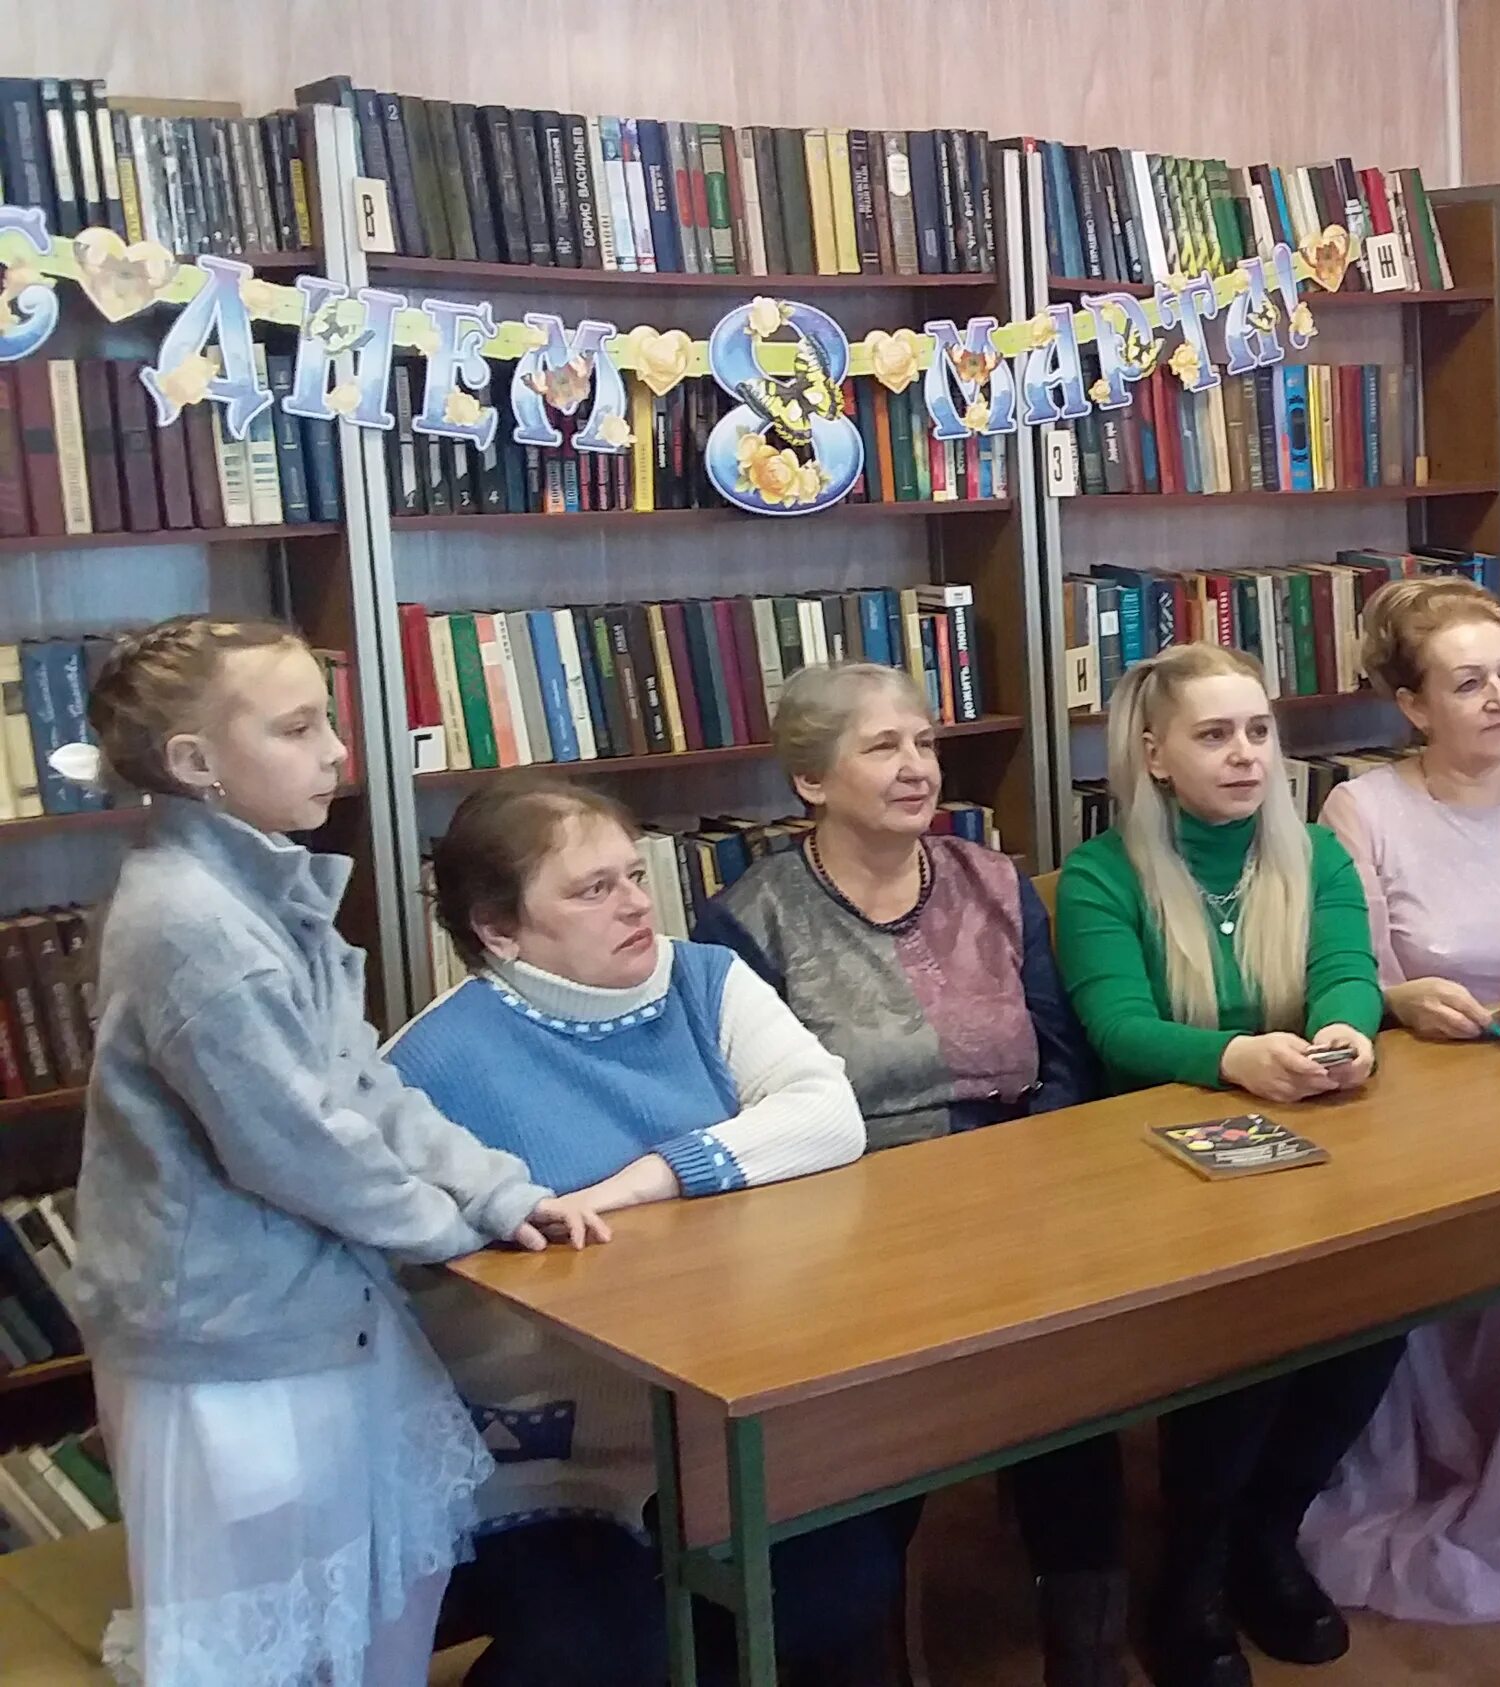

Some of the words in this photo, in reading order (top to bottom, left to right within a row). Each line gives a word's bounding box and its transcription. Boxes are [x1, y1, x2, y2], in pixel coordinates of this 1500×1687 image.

[387, 103, 399, 121] 2
[571, 126, 591, 198] ВАСИЛЬЕВ
[579, 202, 597, 248] БОРИС
[705, 296, 865, 516] 8
[923, 242, 1316, 441] МАРТА!
[413, 733, 433, 769] Г
